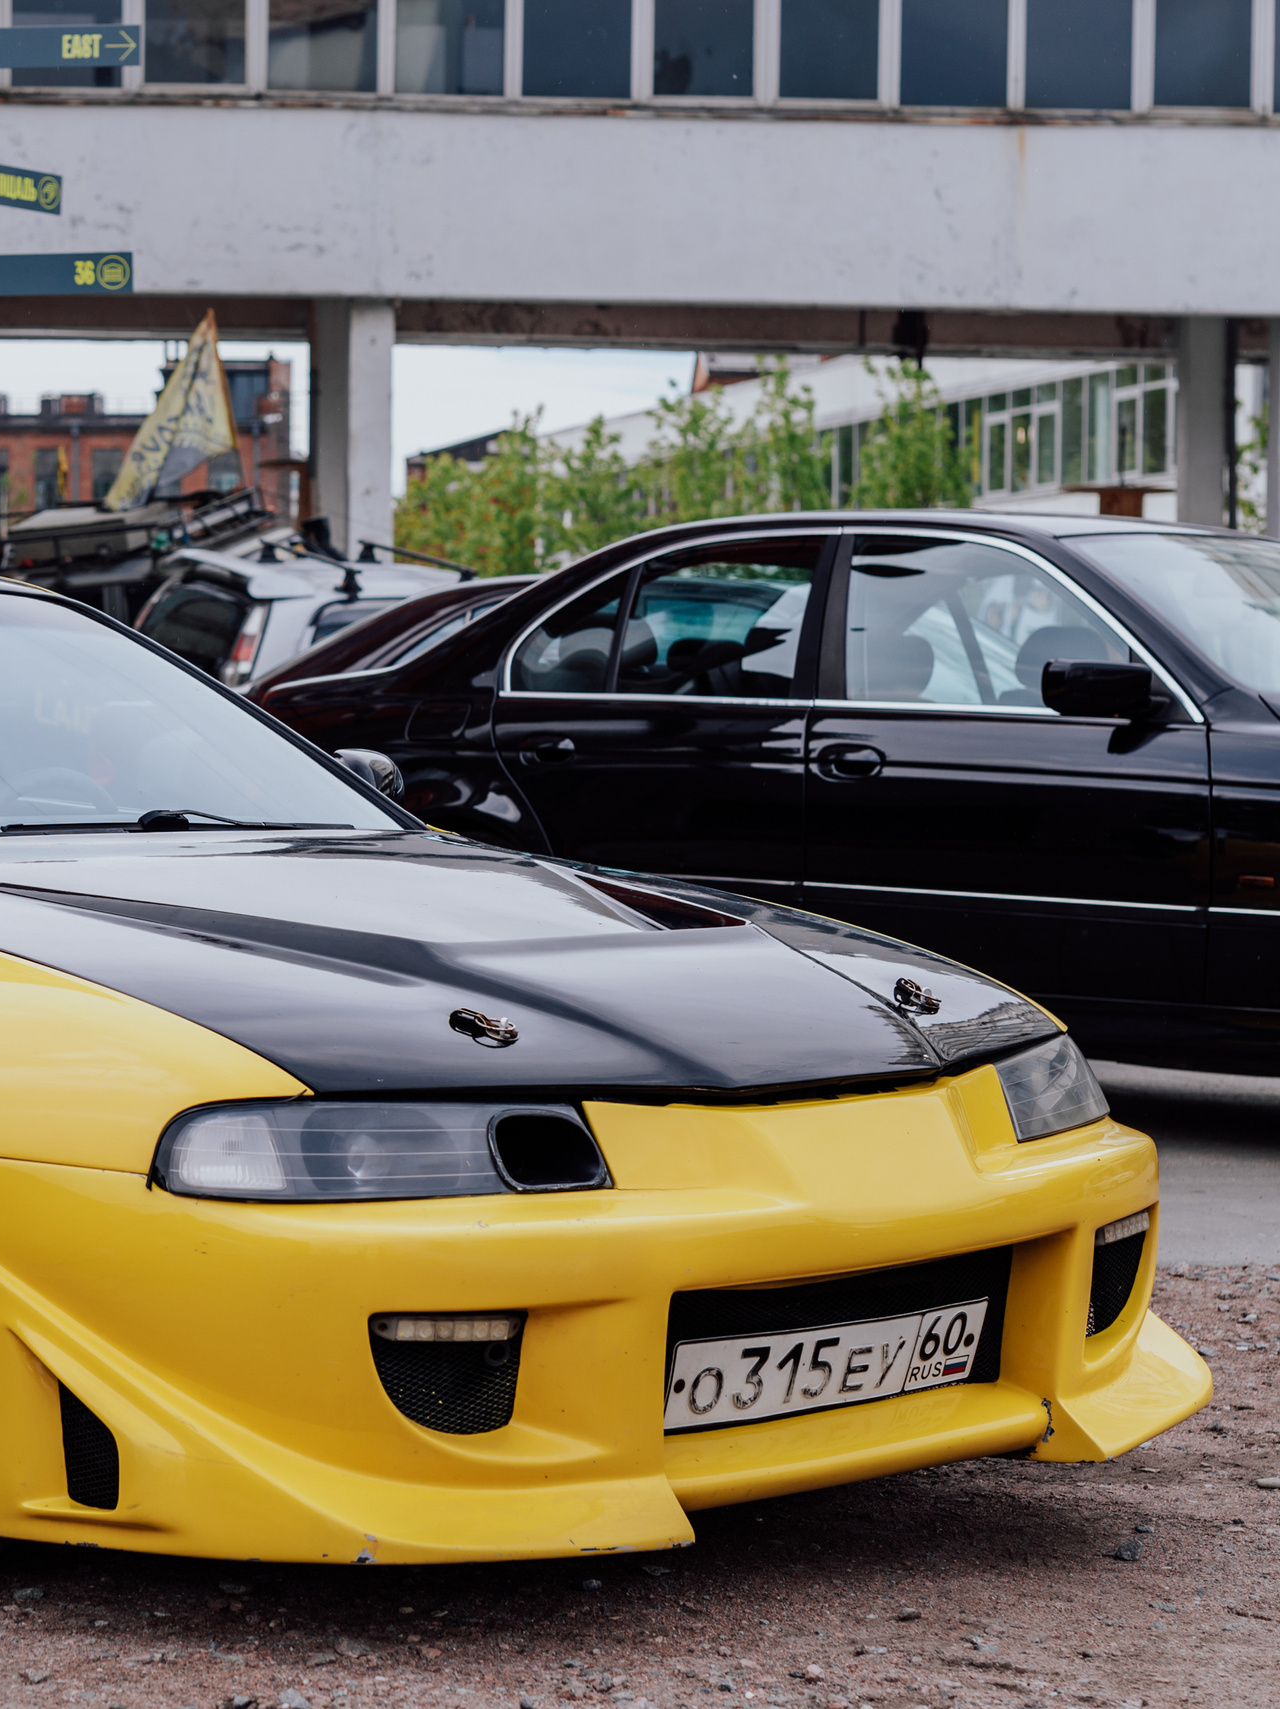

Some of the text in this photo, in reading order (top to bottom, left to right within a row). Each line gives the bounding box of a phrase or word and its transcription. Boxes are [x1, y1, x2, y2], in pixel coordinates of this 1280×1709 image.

[61, 34, 102, 59] EAST
[74, 260, 96, 286] 36
[919, 1310, 969, 1361] 60
[908, 1360, 944, 1383] RUS
